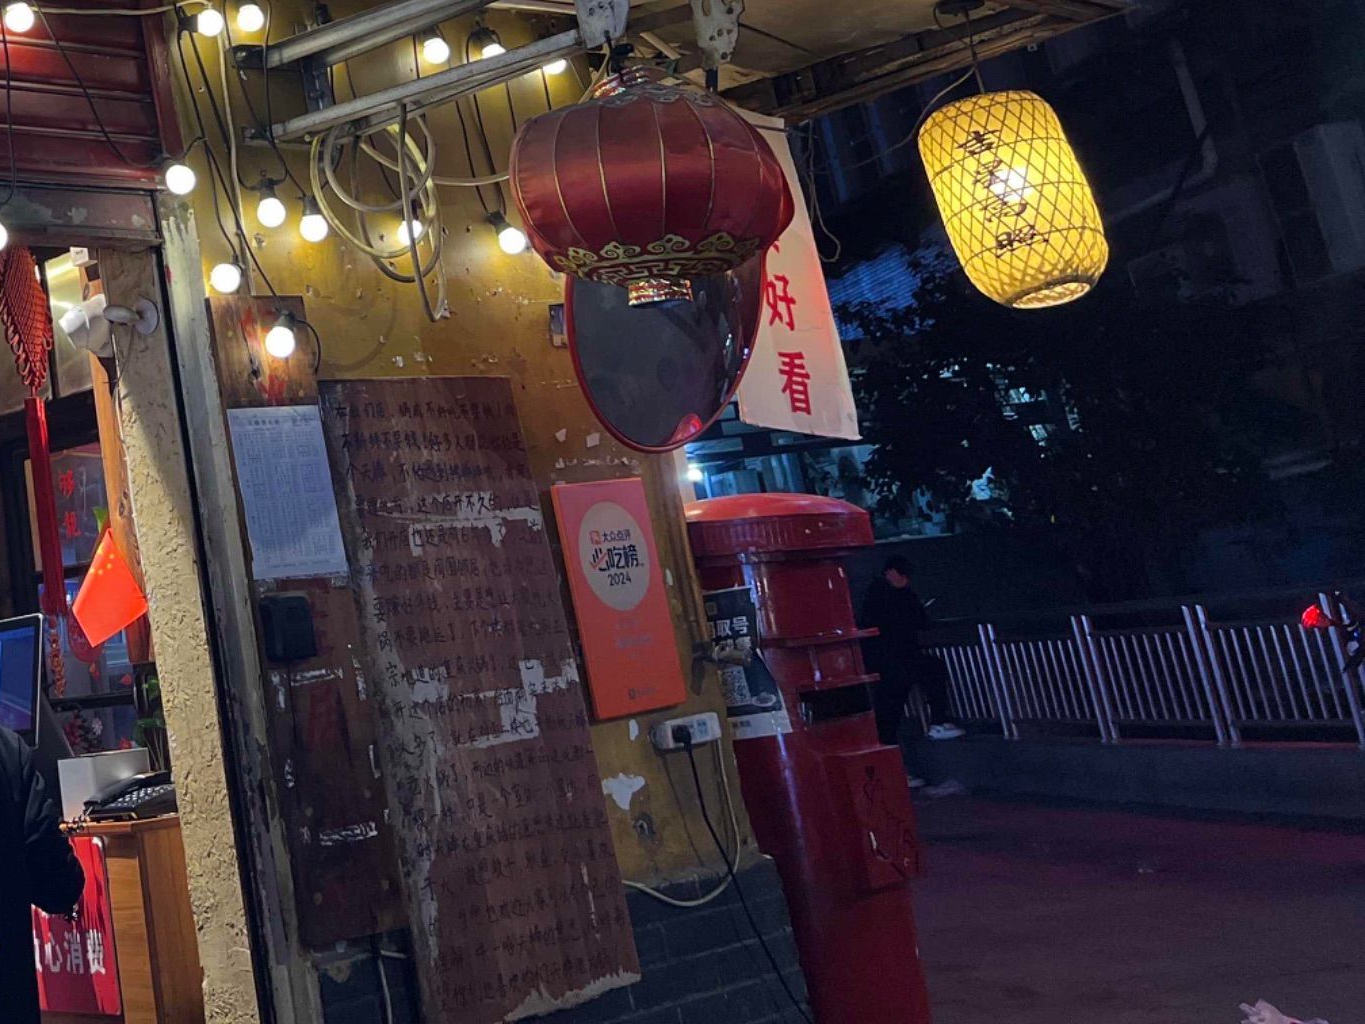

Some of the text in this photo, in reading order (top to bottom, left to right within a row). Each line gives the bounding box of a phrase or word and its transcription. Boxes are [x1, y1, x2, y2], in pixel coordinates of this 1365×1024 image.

[766, 241, 812, 416] 好看
[602, 529, 633, 543] 大众点评
[590, 544, 640, 573] 必吃榜
[607, 573, 632, 587] 2024
